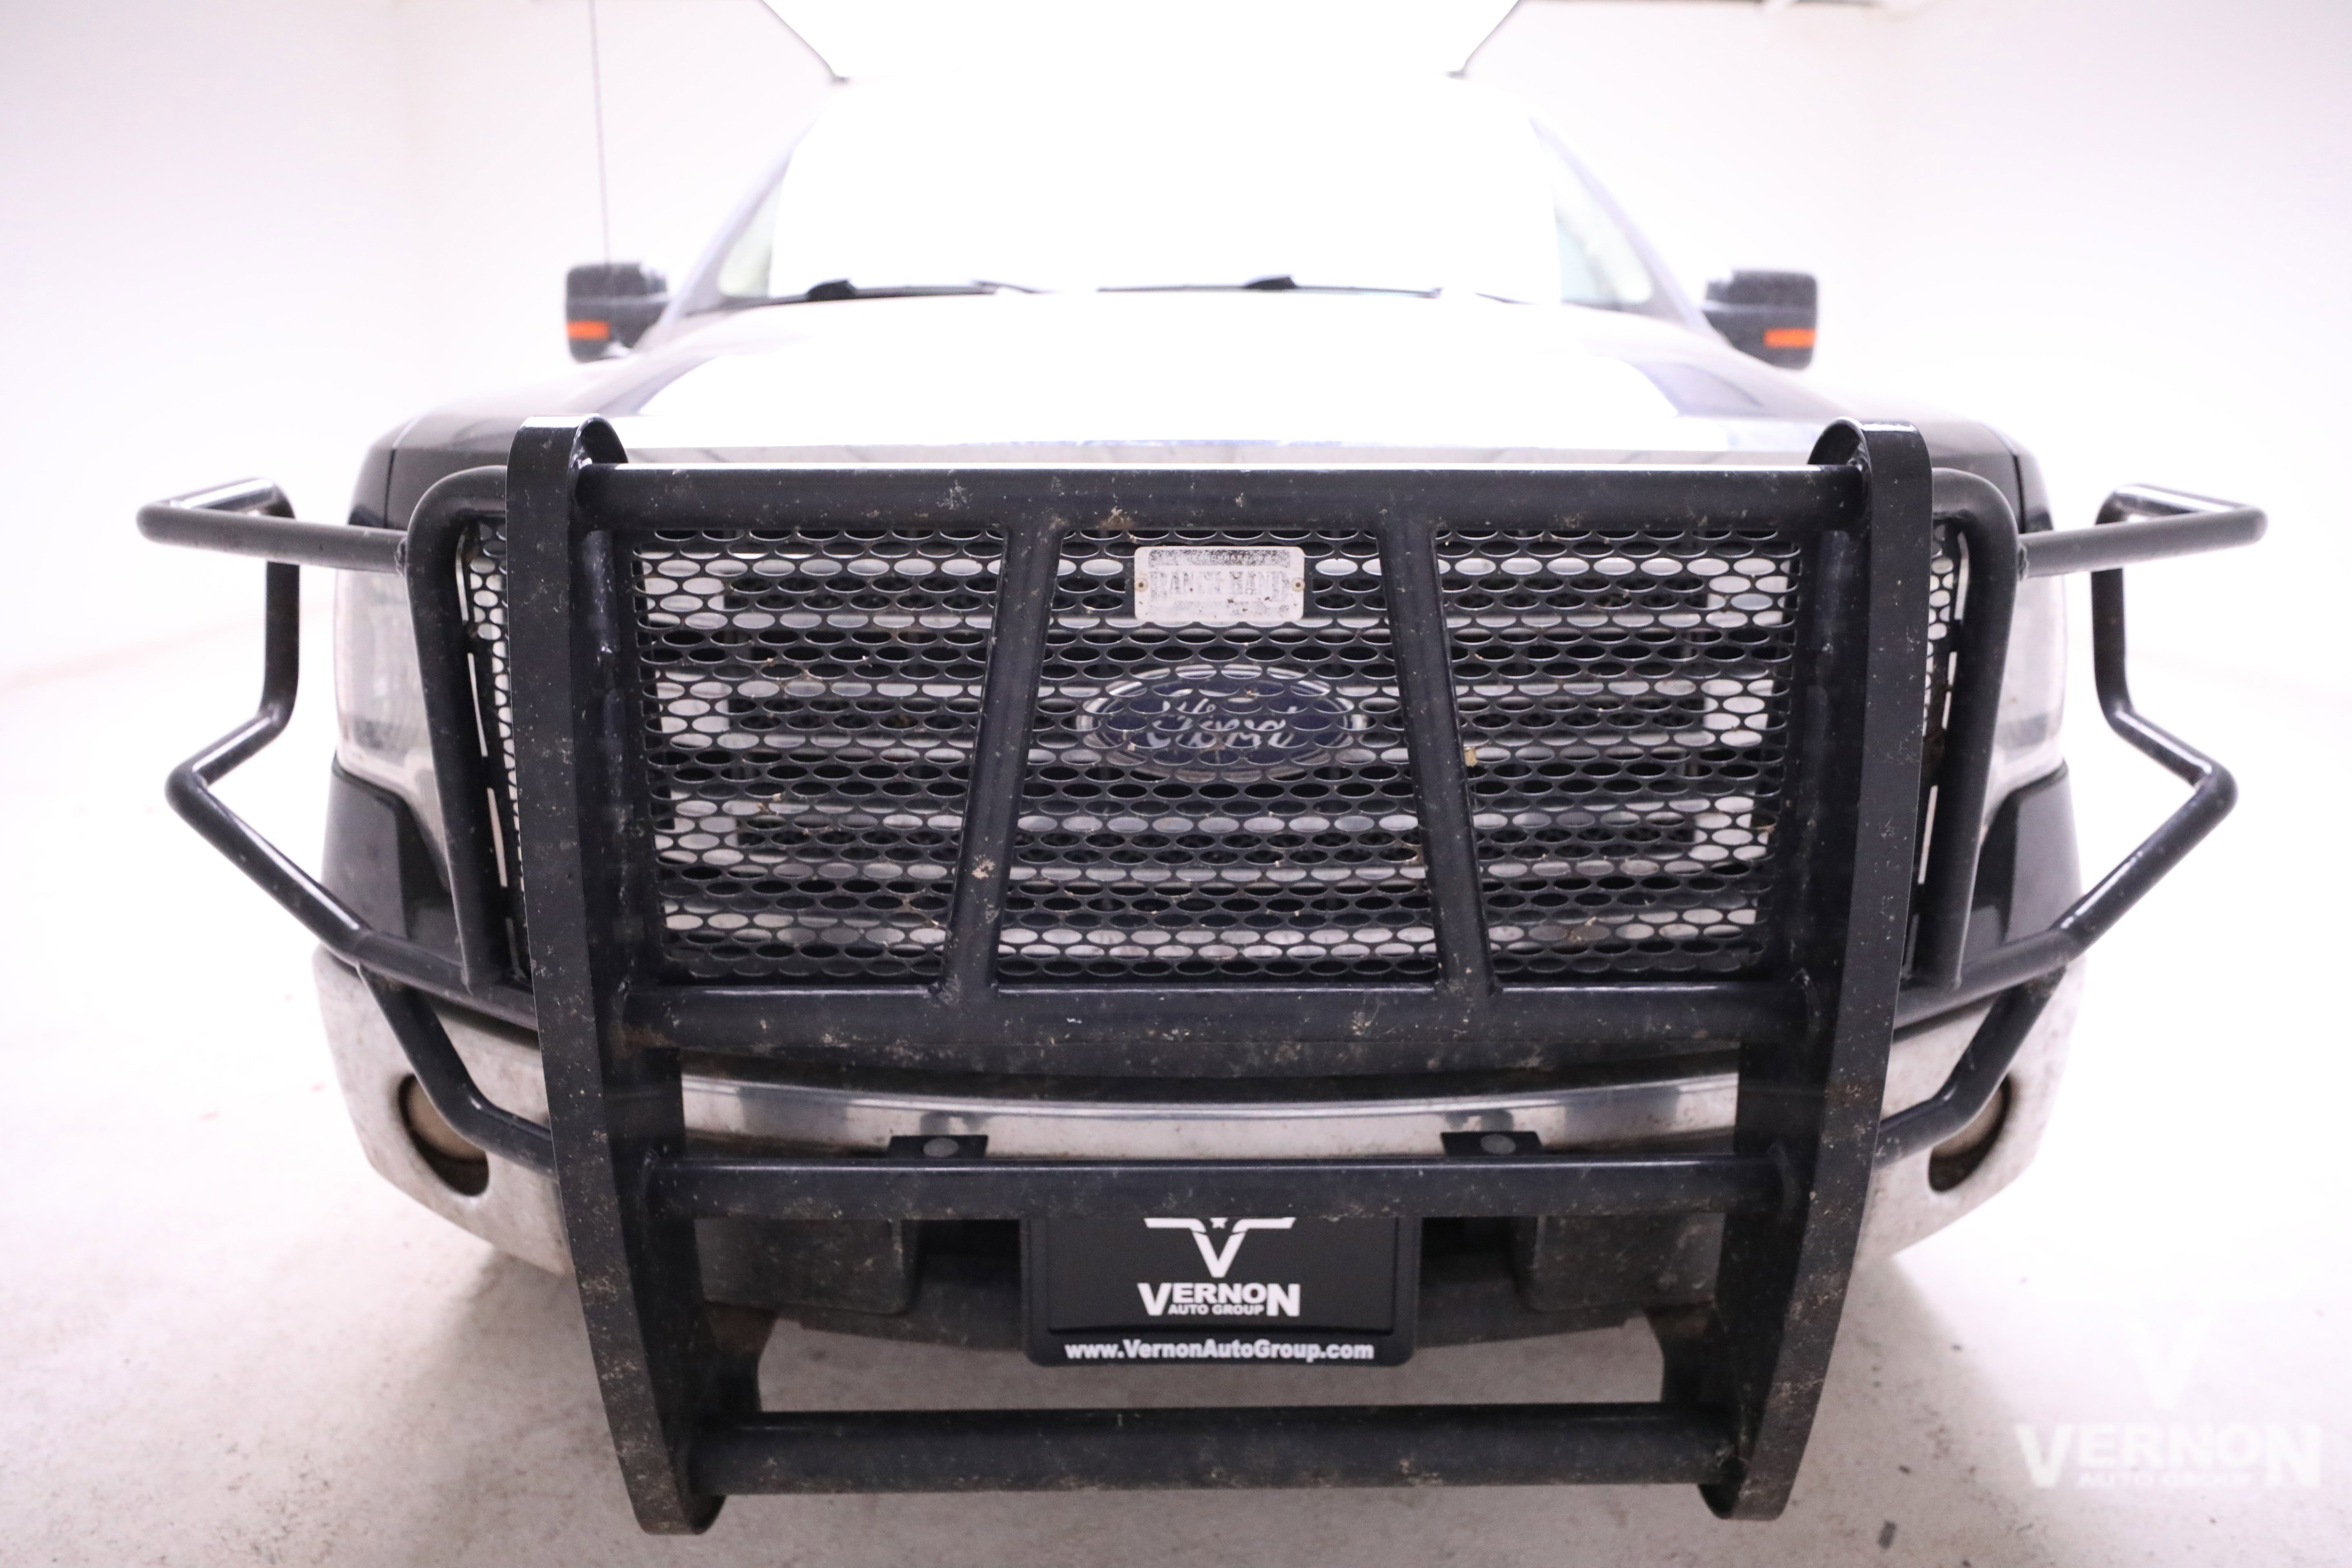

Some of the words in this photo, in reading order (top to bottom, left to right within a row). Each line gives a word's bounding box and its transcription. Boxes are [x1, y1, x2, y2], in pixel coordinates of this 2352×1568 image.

[1137, 1282, 1301, 1317] VERNON
[1167, 1304, 1209, 1316] AUTO
[1211, 1304, 1265, 1316] GROUP
[1064, 1338, 1374, 1363] www.VernonAutoGroup.com
